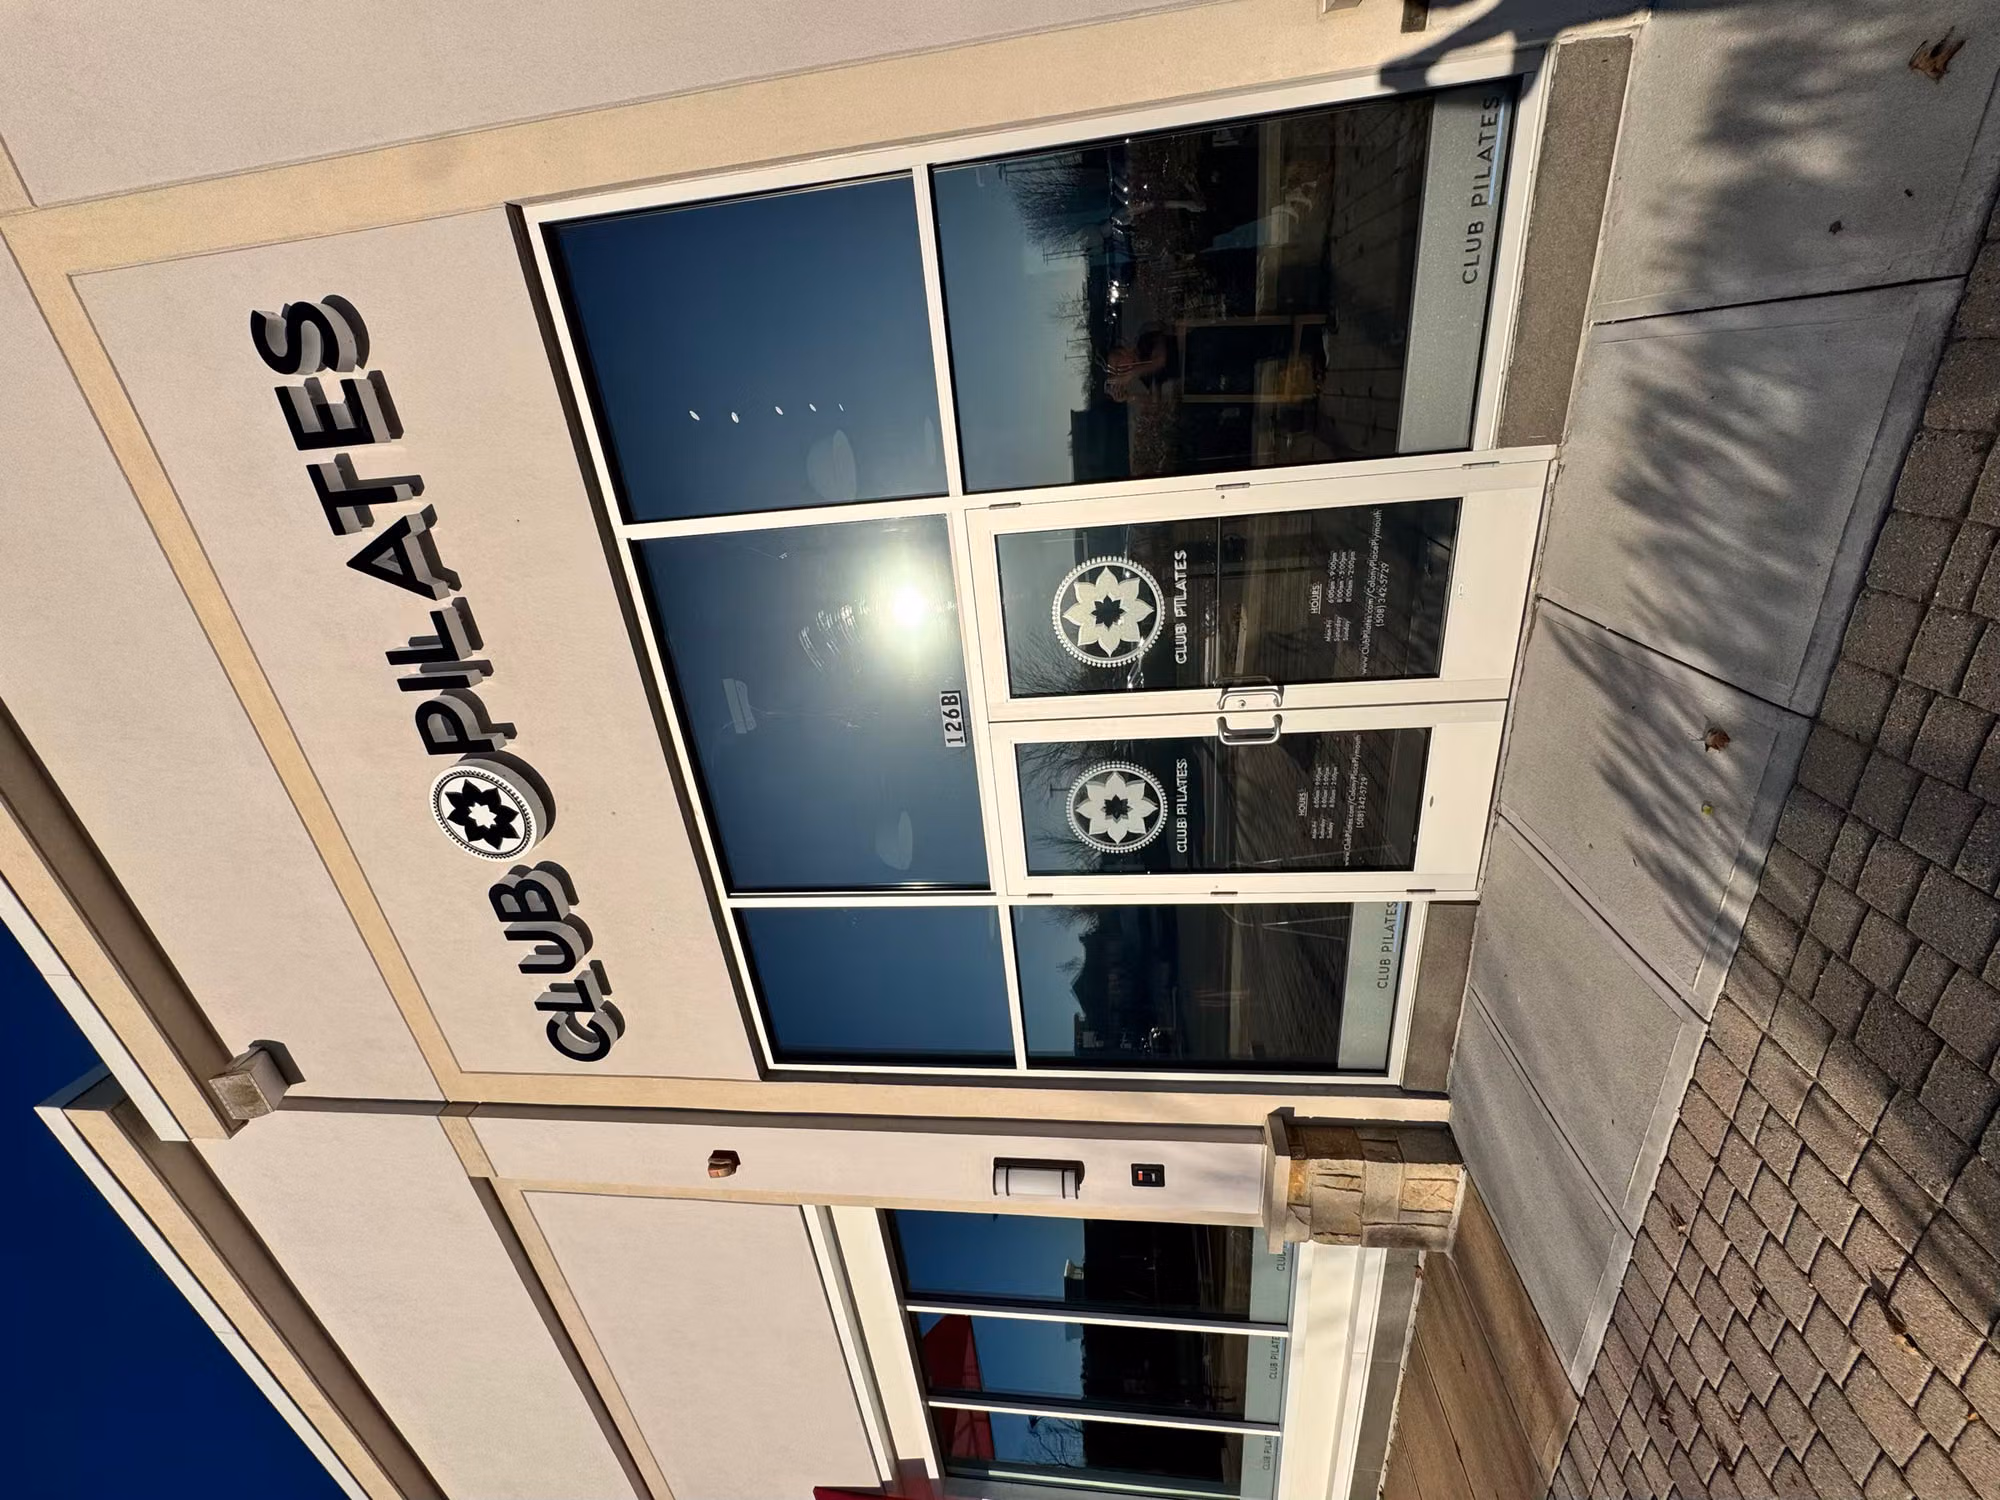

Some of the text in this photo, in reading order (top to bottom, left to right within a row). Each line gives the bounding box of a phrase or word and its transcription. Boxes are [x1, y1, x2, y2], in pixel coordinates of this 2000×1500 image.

[1462, 95, 1500, 284] CLUB PILATES
[1174, 550, 1188, 664] CLUB PILATES
[1310, 584, 1320, 614] HOURS
[1343, 620, 1351, 641] Sunday
[1347, 551, 1356, 574] 2:00pm
[1361, 509, 1383, 674] www.ClubPilates.com/ColonyPlacePlymouth
[1375, 562, 1390, 627] (508) 342-5729
[1334, 616, 1343, 642] Saturday
[249, 301, 613, 1063] CLUB PILATES
[940, 695, 963, 743] 126B
[1176, 760, 1188, 853] CLUB PILATES
[1298, 792, 1306, 816] HOURS
[1356, 776, 1368, 828] (508) 342-5729
[1377, 902, 1398, 989] CLUB PILATES
[1268, 1336, 1280, 1379] CLUB PILATE
[1262, 1435, 1273, 1471] CLUB PILAT
